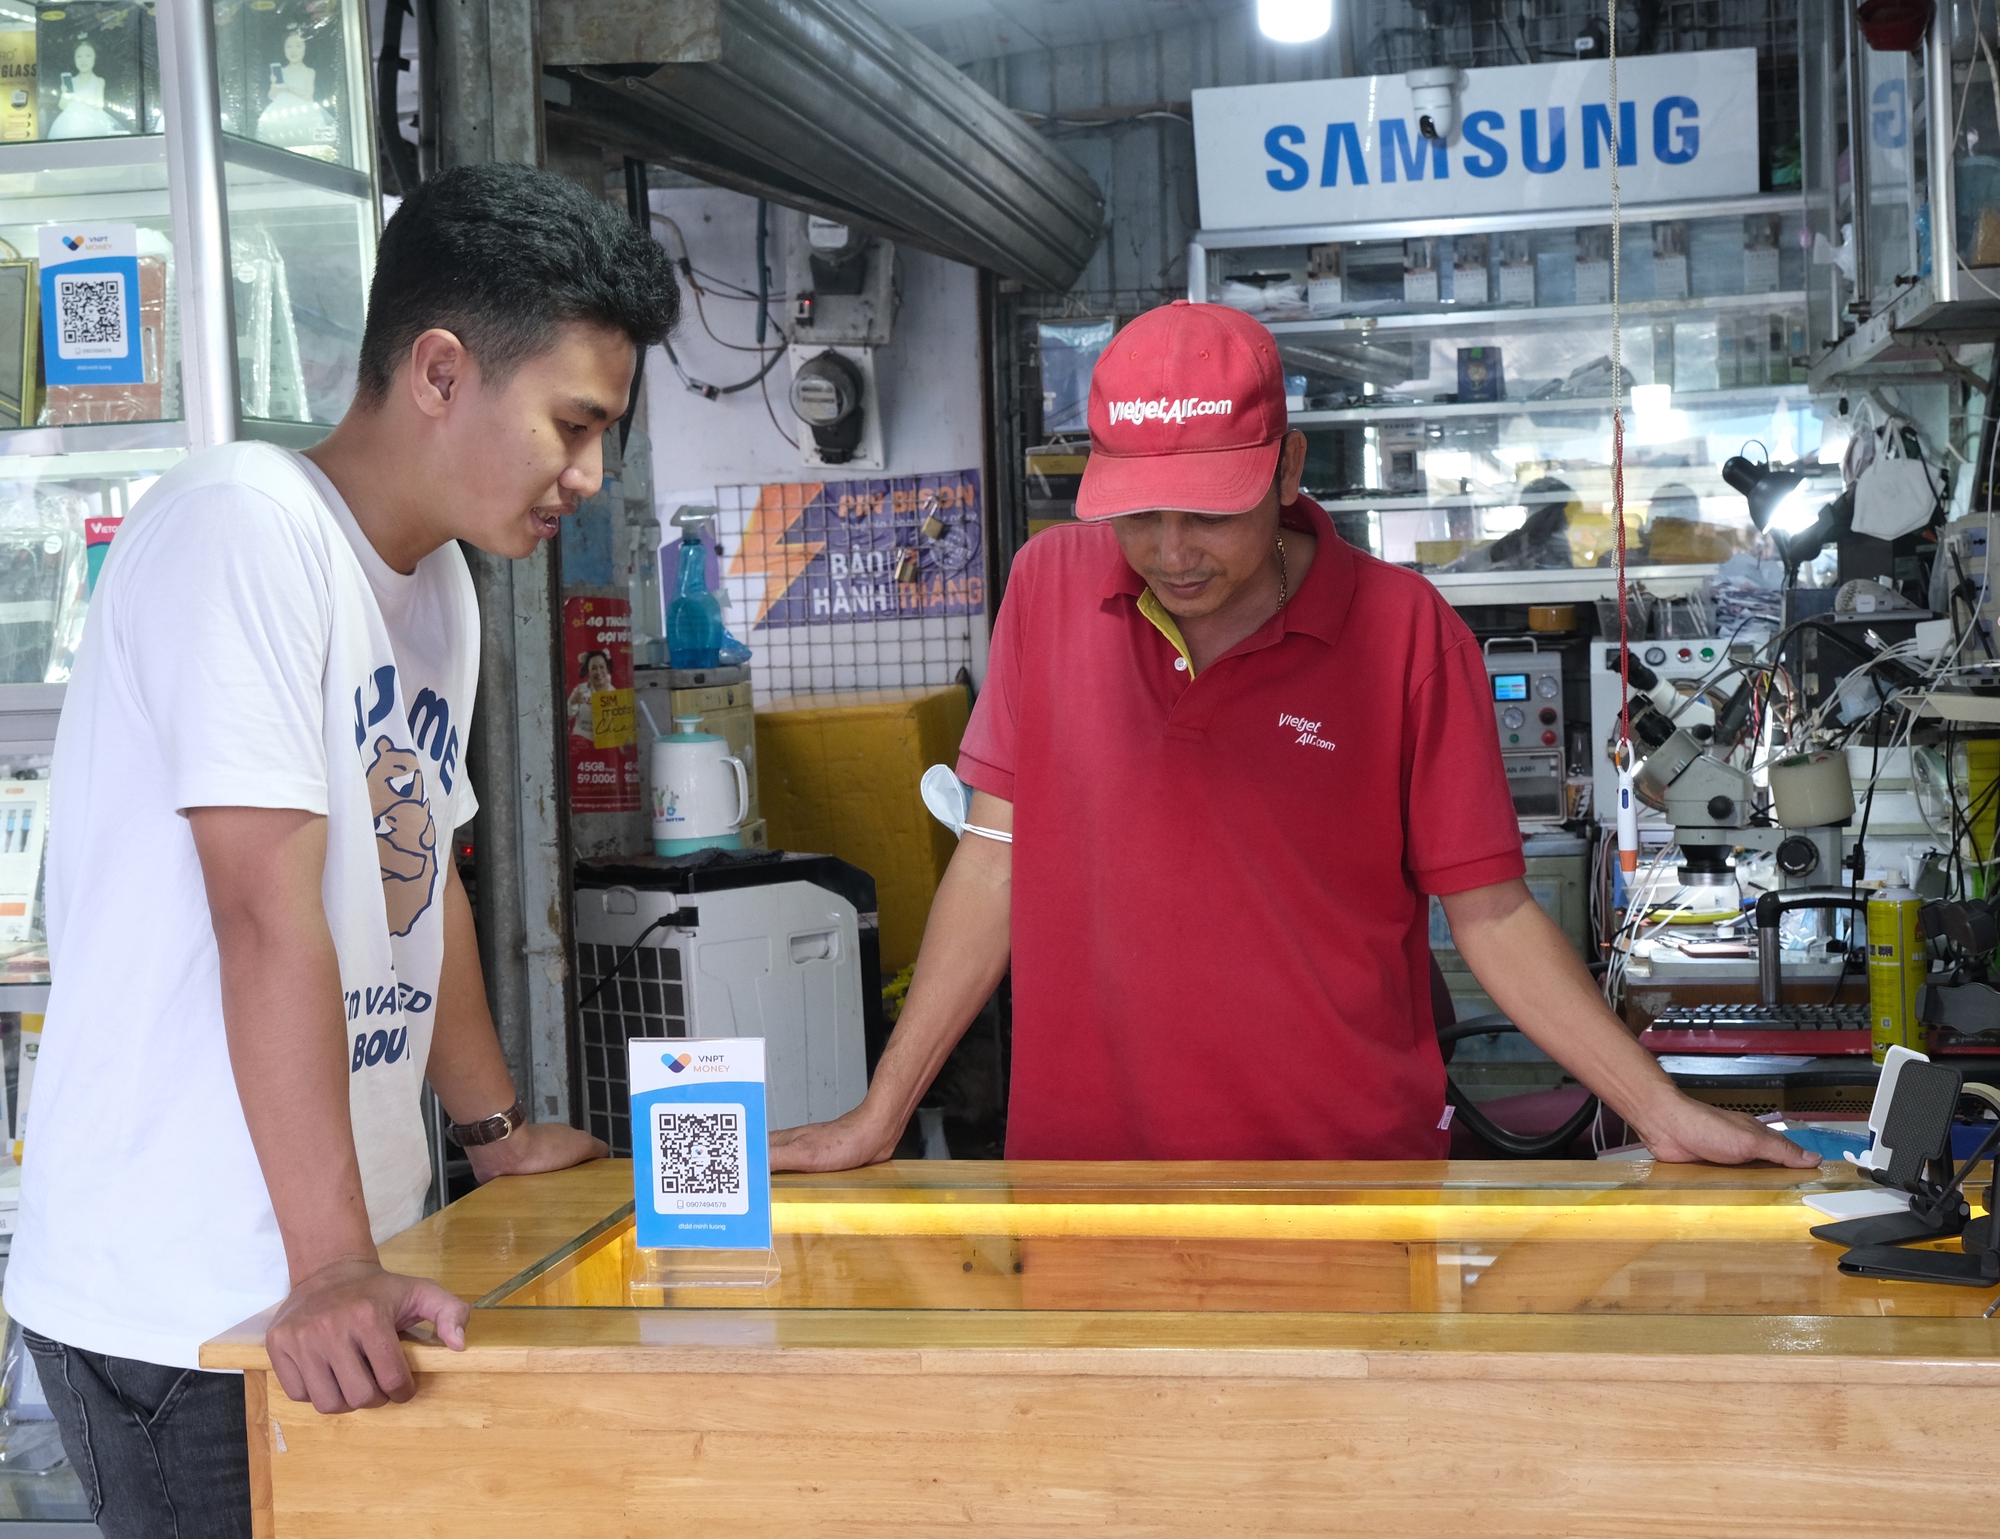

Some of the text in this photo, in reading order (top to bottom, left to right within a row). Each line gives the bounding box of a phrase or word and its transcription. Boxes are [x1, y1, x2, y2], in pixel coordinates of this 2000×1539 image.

[1, 63, 37, 78] GLASS
[1264, 96, 1700, 192] SAMSUNG
[839, 484, 974, 517] PIN BISON
[831, 544, 884, 580] BẢO
[813, 574, 983, 615] HÀNH THÁNG
[600, 695, 618, 707] SIM
[577, 762, 605, 771] 45GB
[698, 1055, 725, 1063] VNPT
[693, 1065, 730, 1073] MONEY
